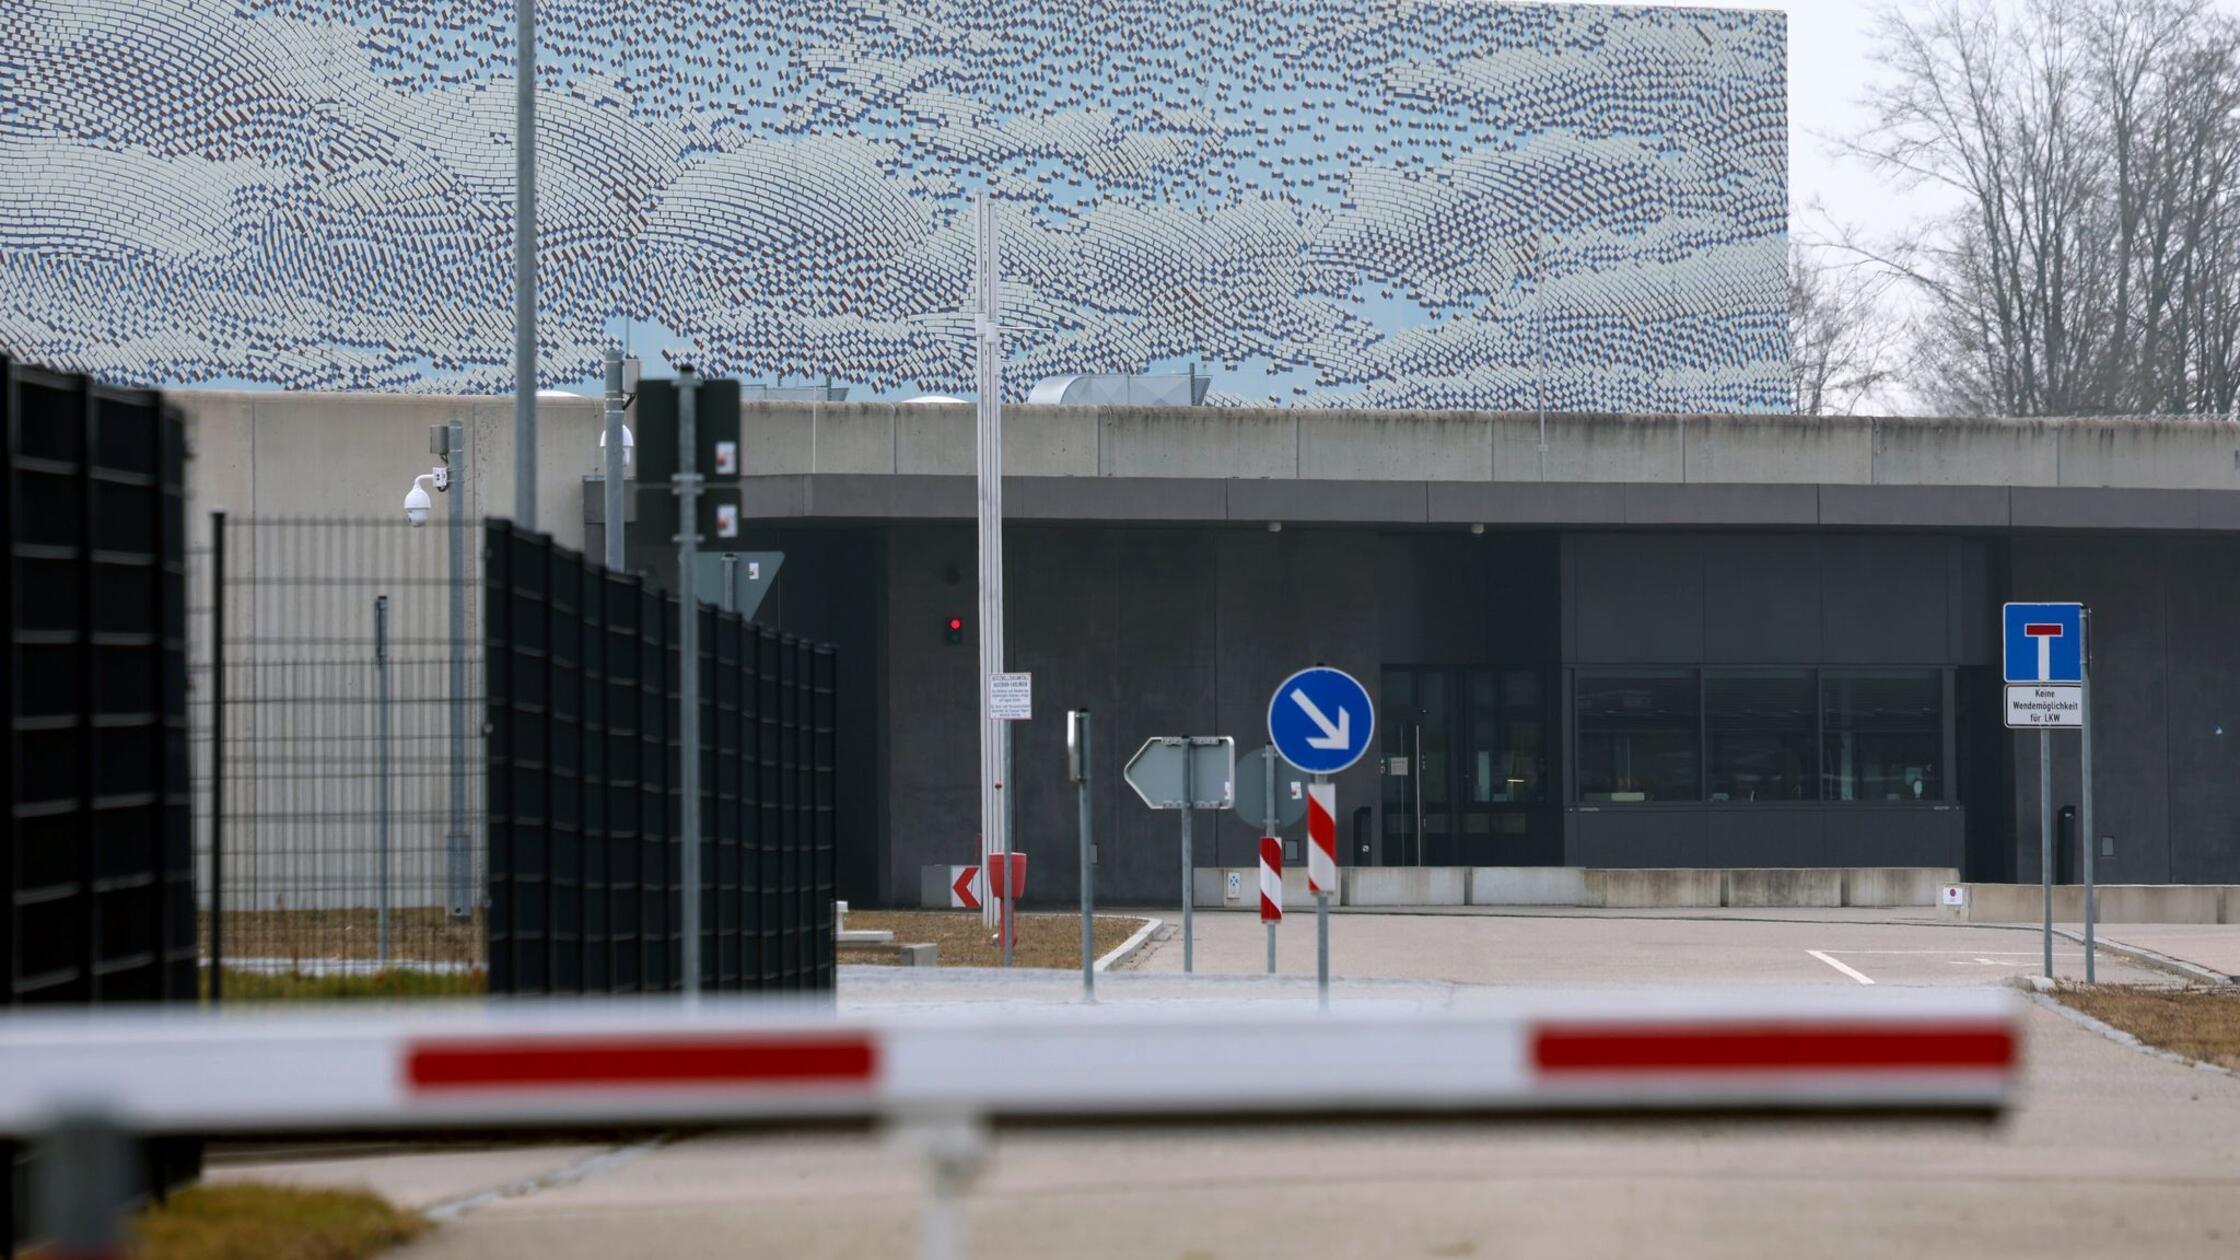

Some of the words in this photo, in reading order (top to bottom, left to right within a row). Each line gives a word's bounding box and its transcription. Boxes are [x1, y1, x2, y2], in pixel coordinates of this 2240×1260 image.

[2035, 690, 2055, 698] Keine
[2013, 701, 2078, 711] Wendemöglichkeit
[2030, 714, 2041, 722] für
[2044, 714, 2061, 722] LKW
